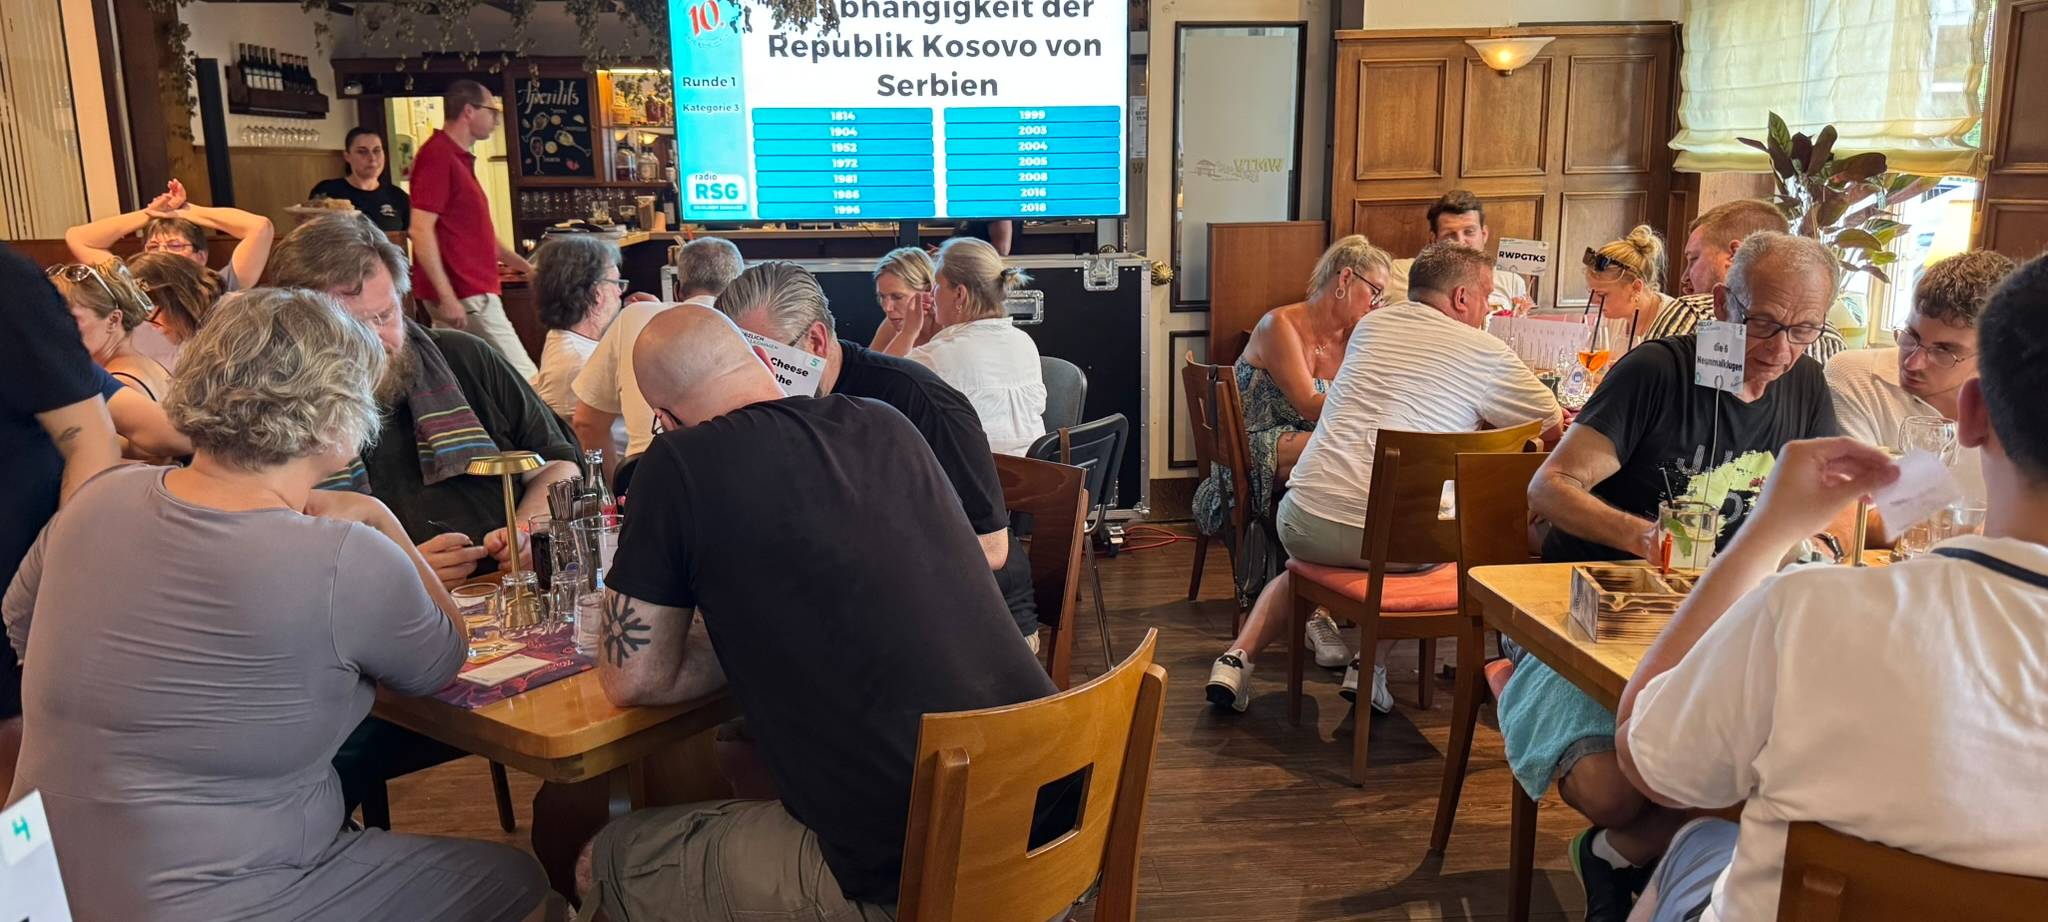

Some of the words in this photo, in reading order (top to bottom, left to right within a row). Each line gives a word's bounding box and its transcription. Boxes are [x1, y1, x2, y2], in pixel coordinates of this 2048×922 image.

[1042, 0, 1095, 18] der
[768, 32, 914, 63] Republik
[922, 34, 1038, 58] Kosovo
[1046, 38, 1102, 57] von
[682, 76, 728, 87] Runde
[731, 77, 736, 87] 1
[877, 71, 998, 97] Serbien
[682, 103, 732, 113] Kategorie
[734, 104, 740, 112] 3
[830, 127, 858, 137] 1904
[1018, 125, 1048, 136] 2003
[831, 143, 858, 153] 1952
[1018, 141, 1048, 152] 2004
[832, 158, 859, 169] 1972
[695, 173, 718, 181] radio
[695, 183, 739, 200] RSG
[1498, 250, 1546, 263] RWPGTKS
[770, 356, 809, 377] Cheese
[810, 357, 820, 367] 5
